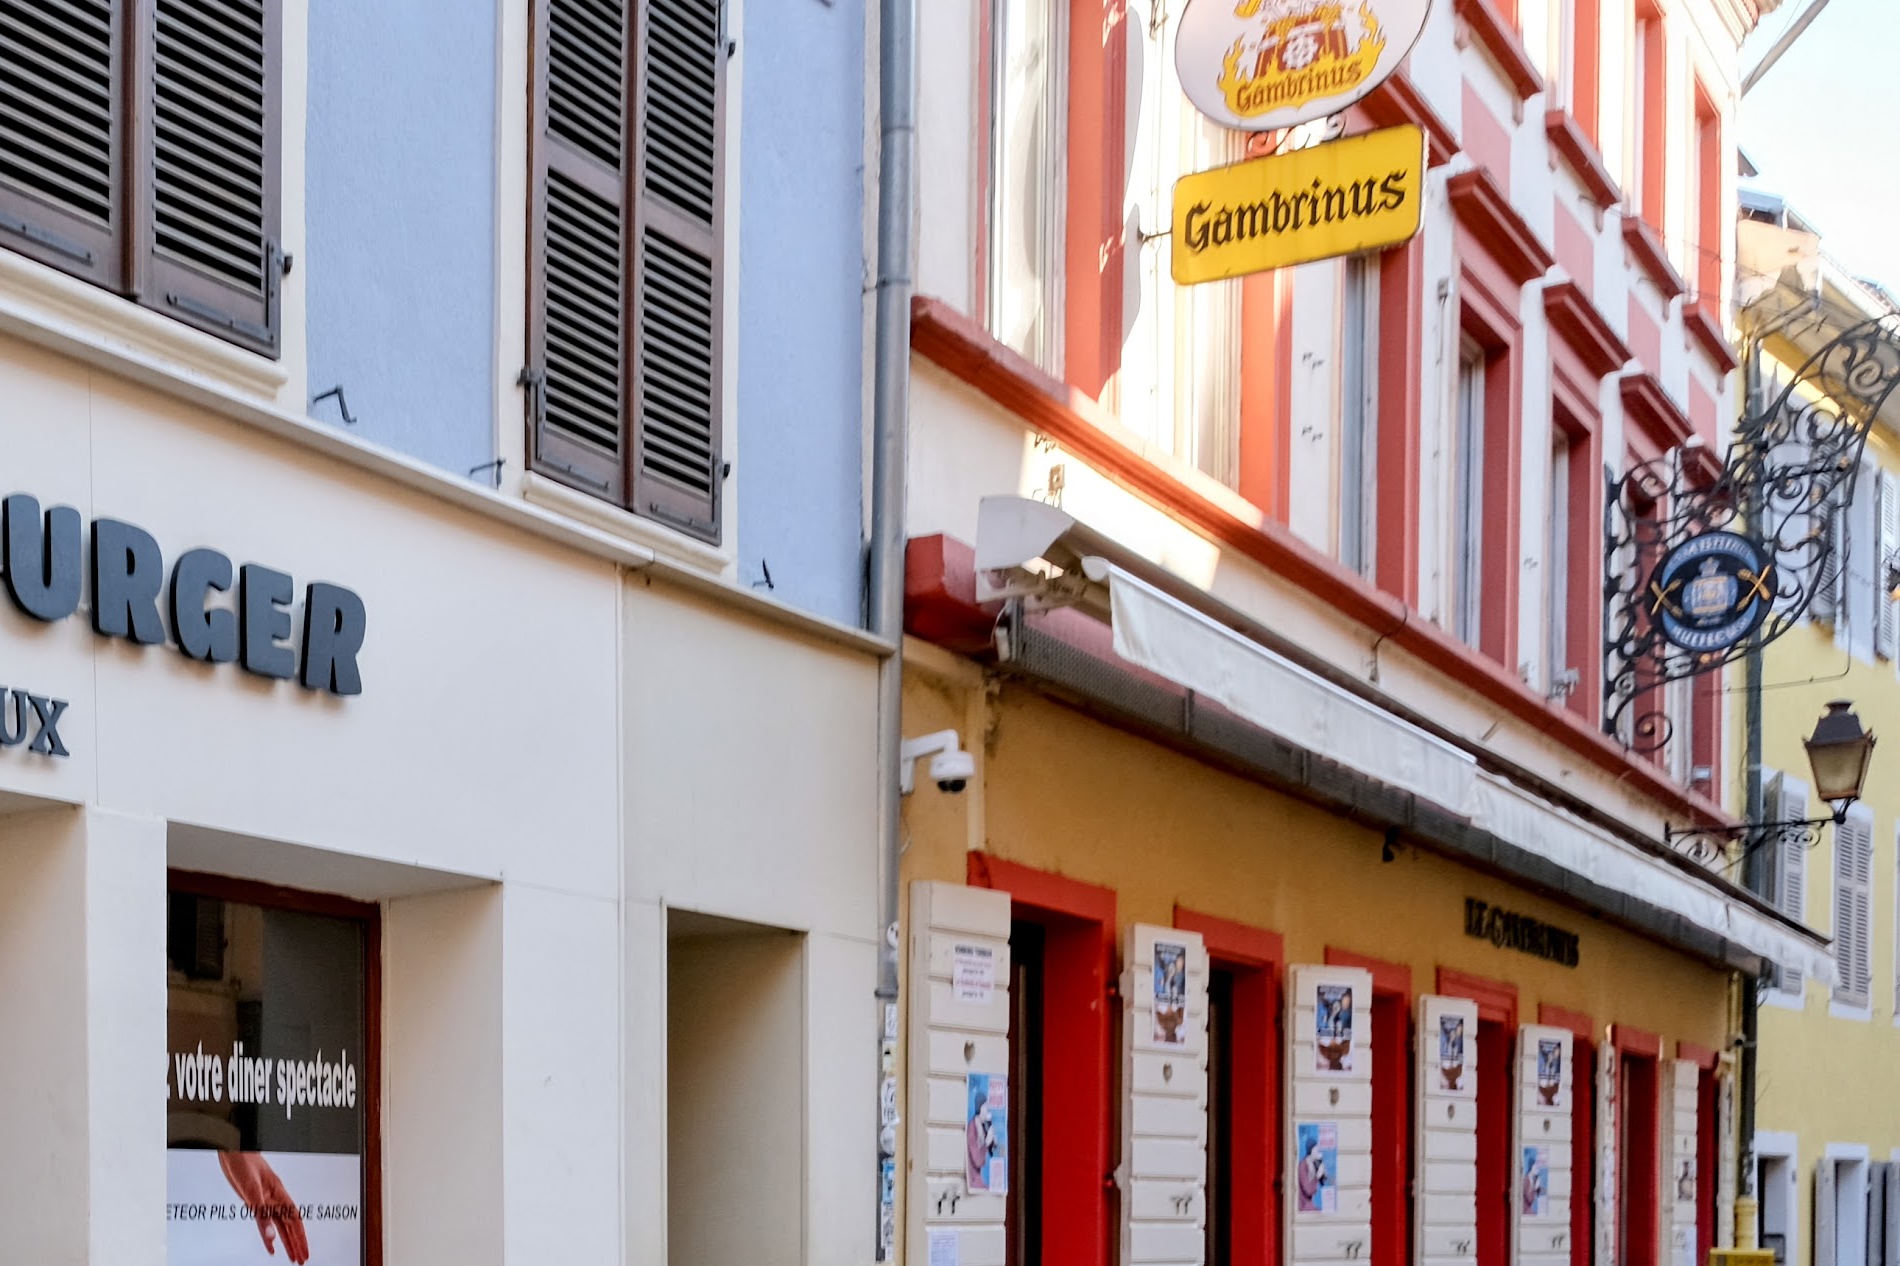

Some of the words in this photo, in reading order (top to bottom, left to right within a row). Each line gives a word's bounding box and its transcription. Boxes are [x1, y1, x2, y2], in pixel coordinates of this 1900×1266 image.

[1235, 57, 1362, 113] Gambrinus
[1184, 168, 1407, 255] Gambrinus
[175, 1040, 223, 1102] votre
[227, 1040, 272, 1104] diner
[277, 1049, 356, 1120] spectacle
[210, 1203, 236, 1220] PILS
[240, 1204, 258, 1220] OU
[298, 1204, 313, 1220] DE
[316, 1203, 358, 1220] SAISON
